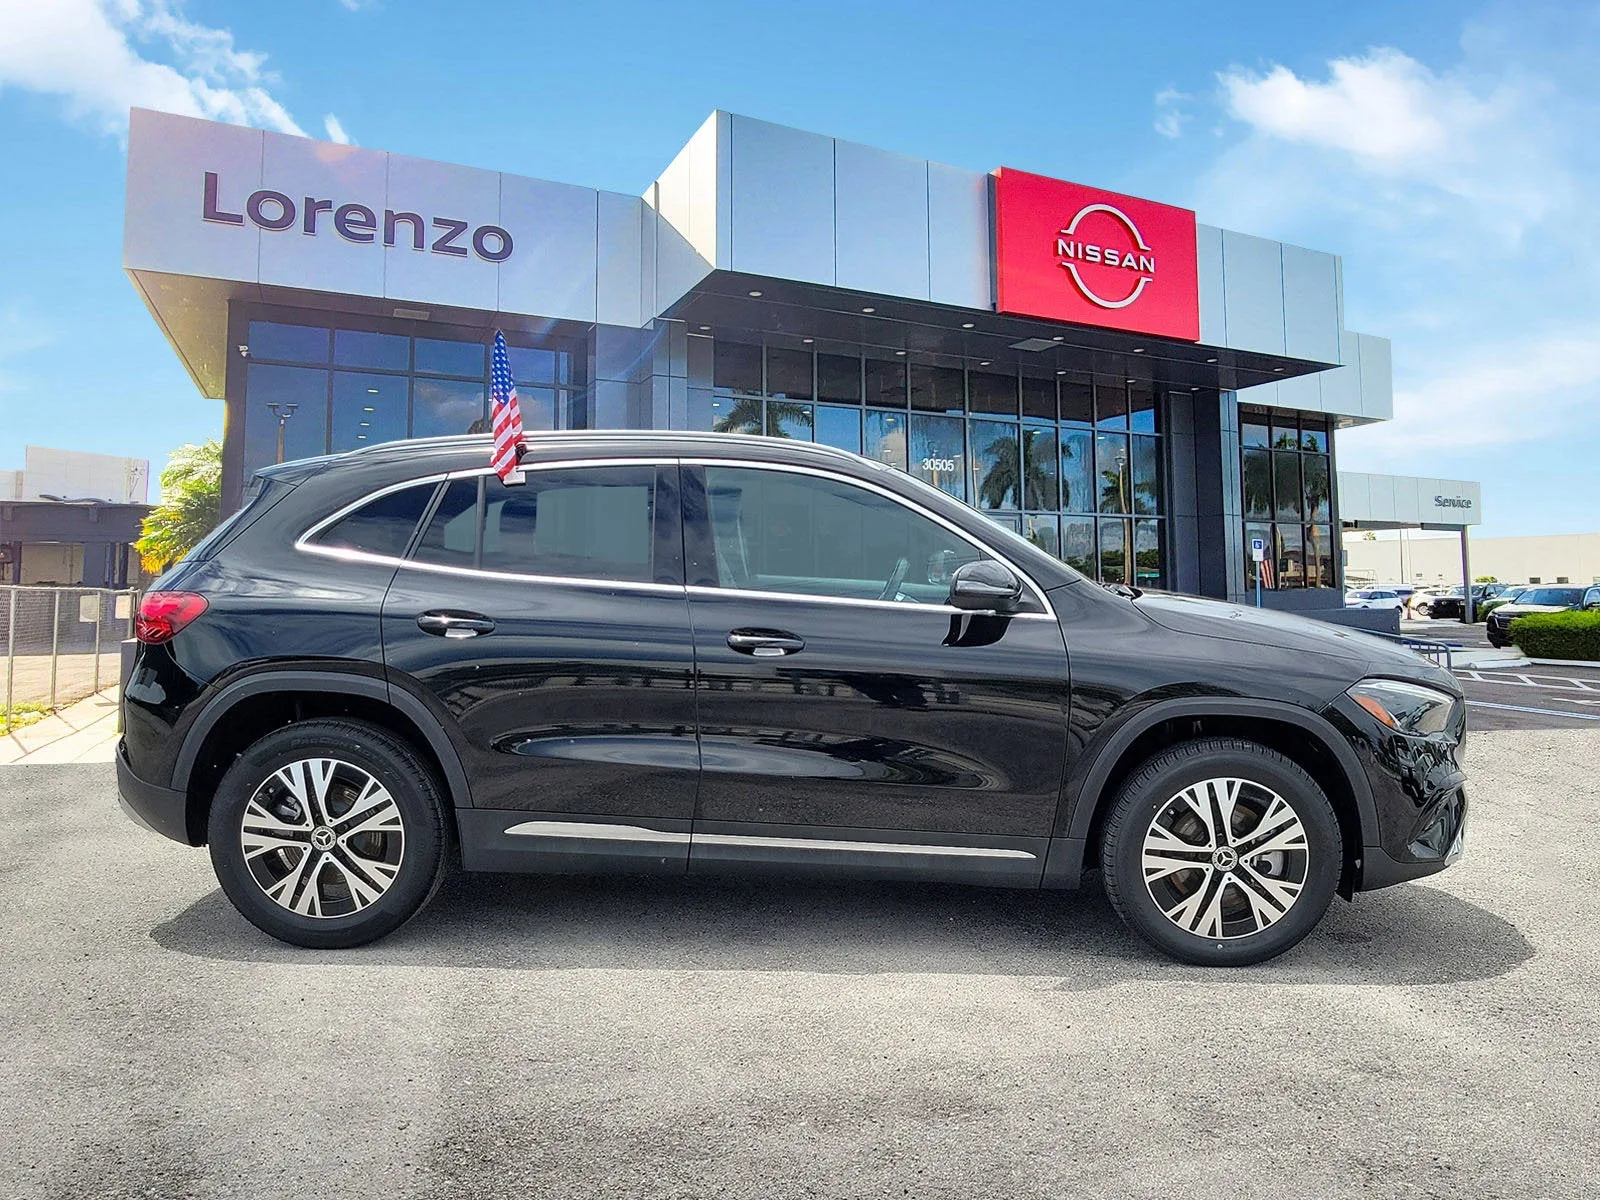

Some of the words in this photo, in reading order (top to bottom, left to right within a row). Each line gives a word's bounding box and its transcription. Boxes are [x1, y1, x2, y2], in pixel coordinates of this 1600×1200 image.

[203, 171, 514, 262] Lorenzo
[1057, 238, 1155, 273] NISSAN
[922, 458, 954, 471] 30505
[1434, 495, 1472, 508] Service
